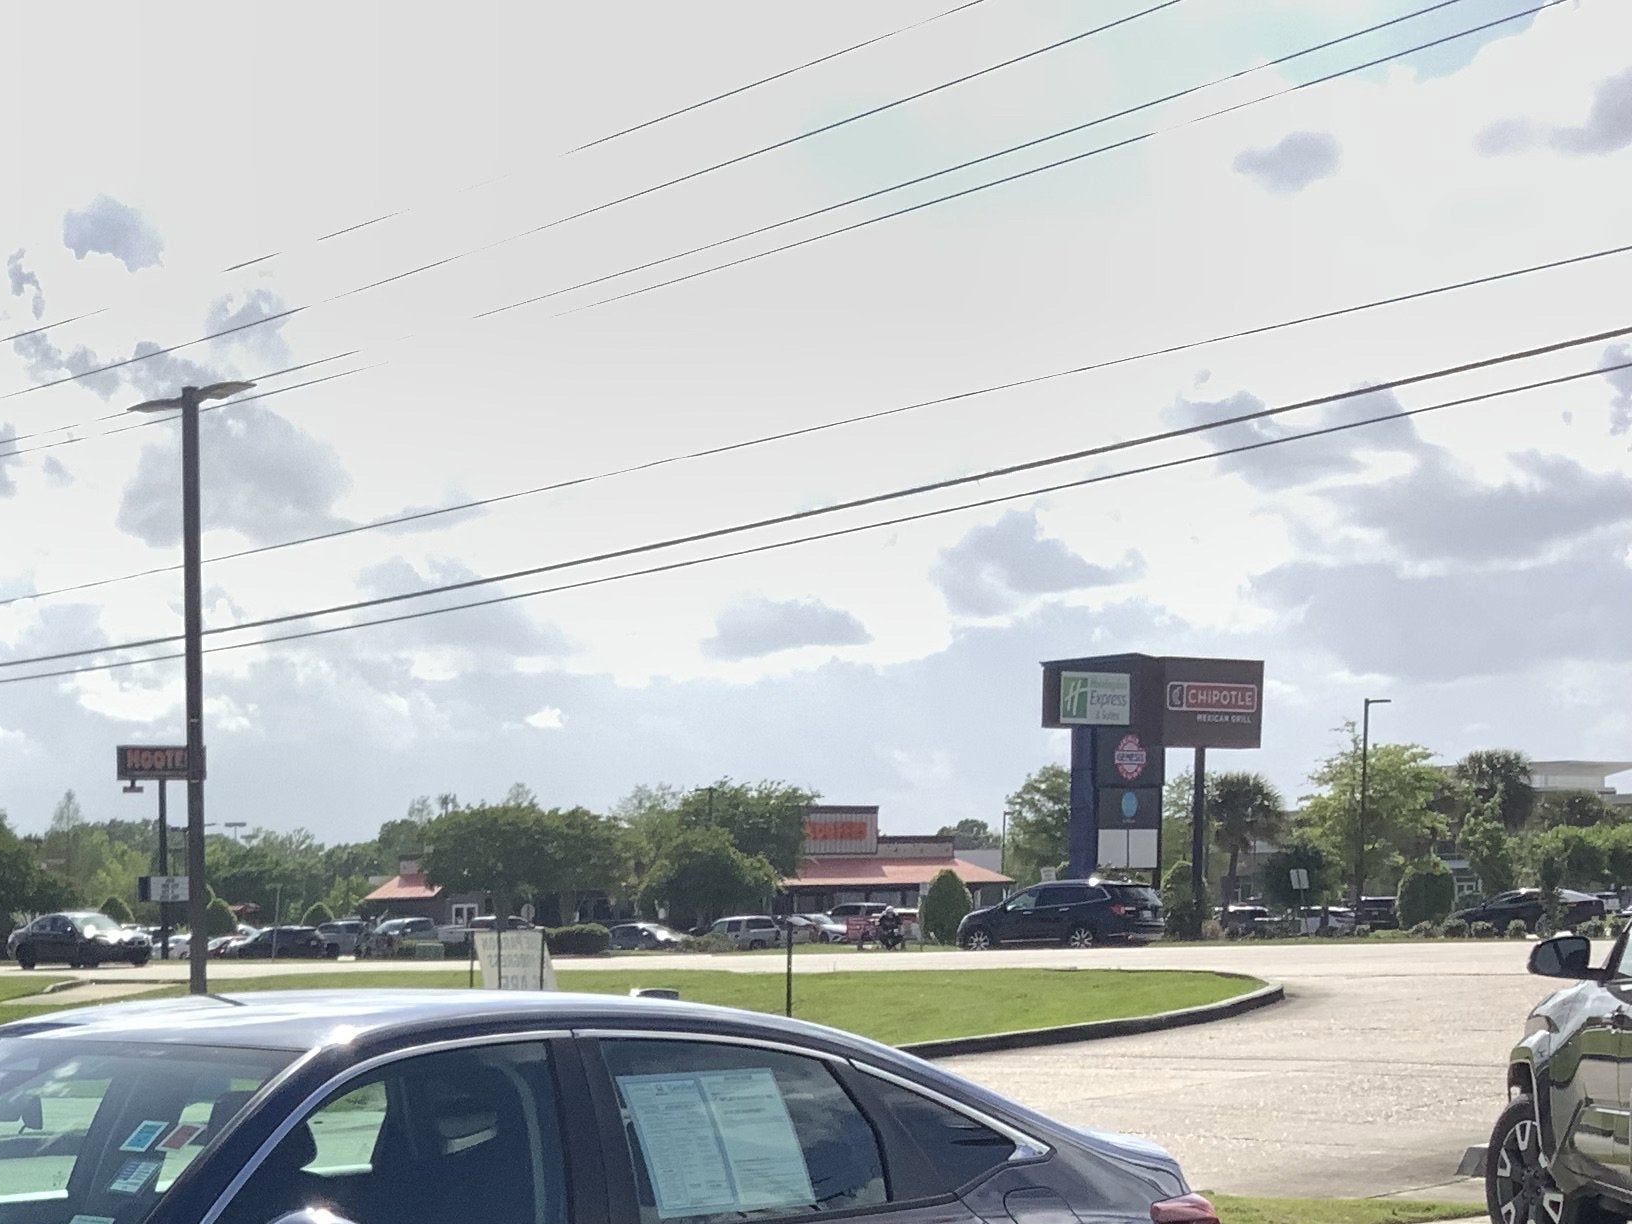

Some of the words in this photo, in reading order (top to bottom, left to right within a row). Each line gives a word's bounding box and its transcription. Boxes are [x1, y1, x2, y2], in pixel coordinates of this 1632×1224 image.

[1089, 690, 1128, 708] Express
[1188, 689, 1253, 706] CHIPOTLE
[1196, 713, 1230, 723] MEXICAN
[1231, 715, 1252, 724] GRILL
[127, 750, 188, 769] HOOTE
